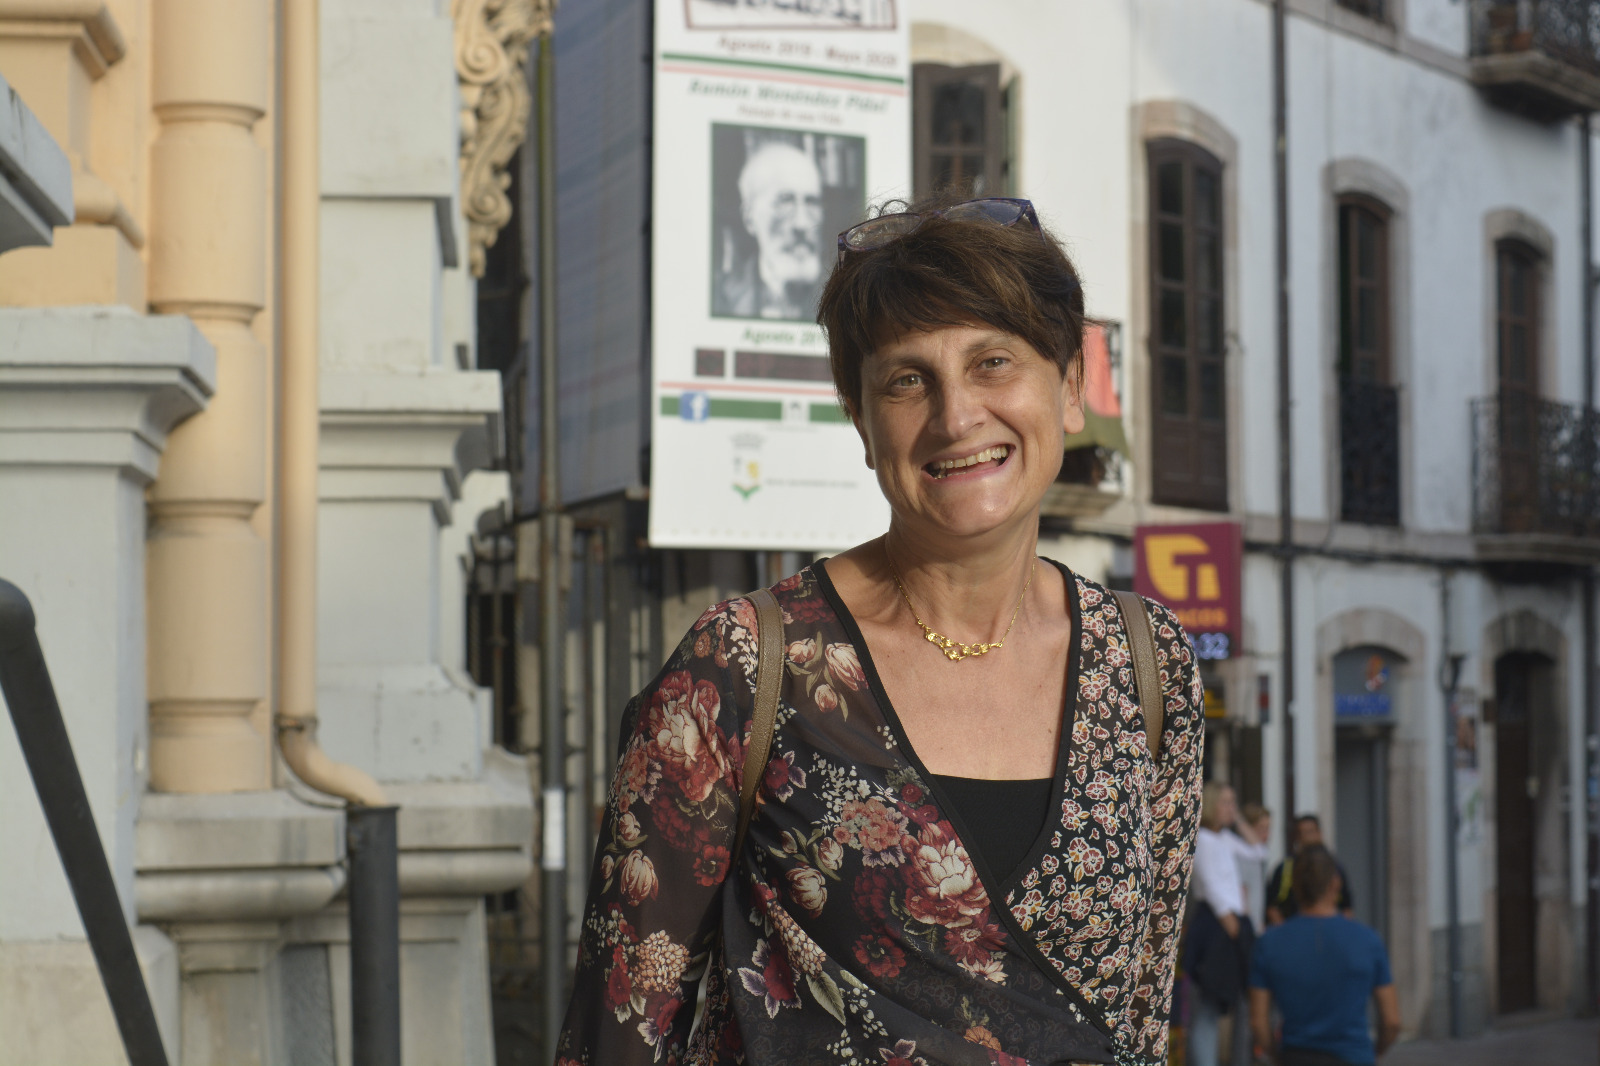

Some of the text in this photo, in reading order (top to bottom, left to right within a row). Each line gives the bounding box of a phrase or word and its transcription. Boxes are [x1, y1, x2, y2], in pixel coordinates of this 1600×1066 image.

[718, 36, 772, 54] Agosto
[689, 79, 749, 96] Ramón
[743, 328, 794, 345] Agosto
